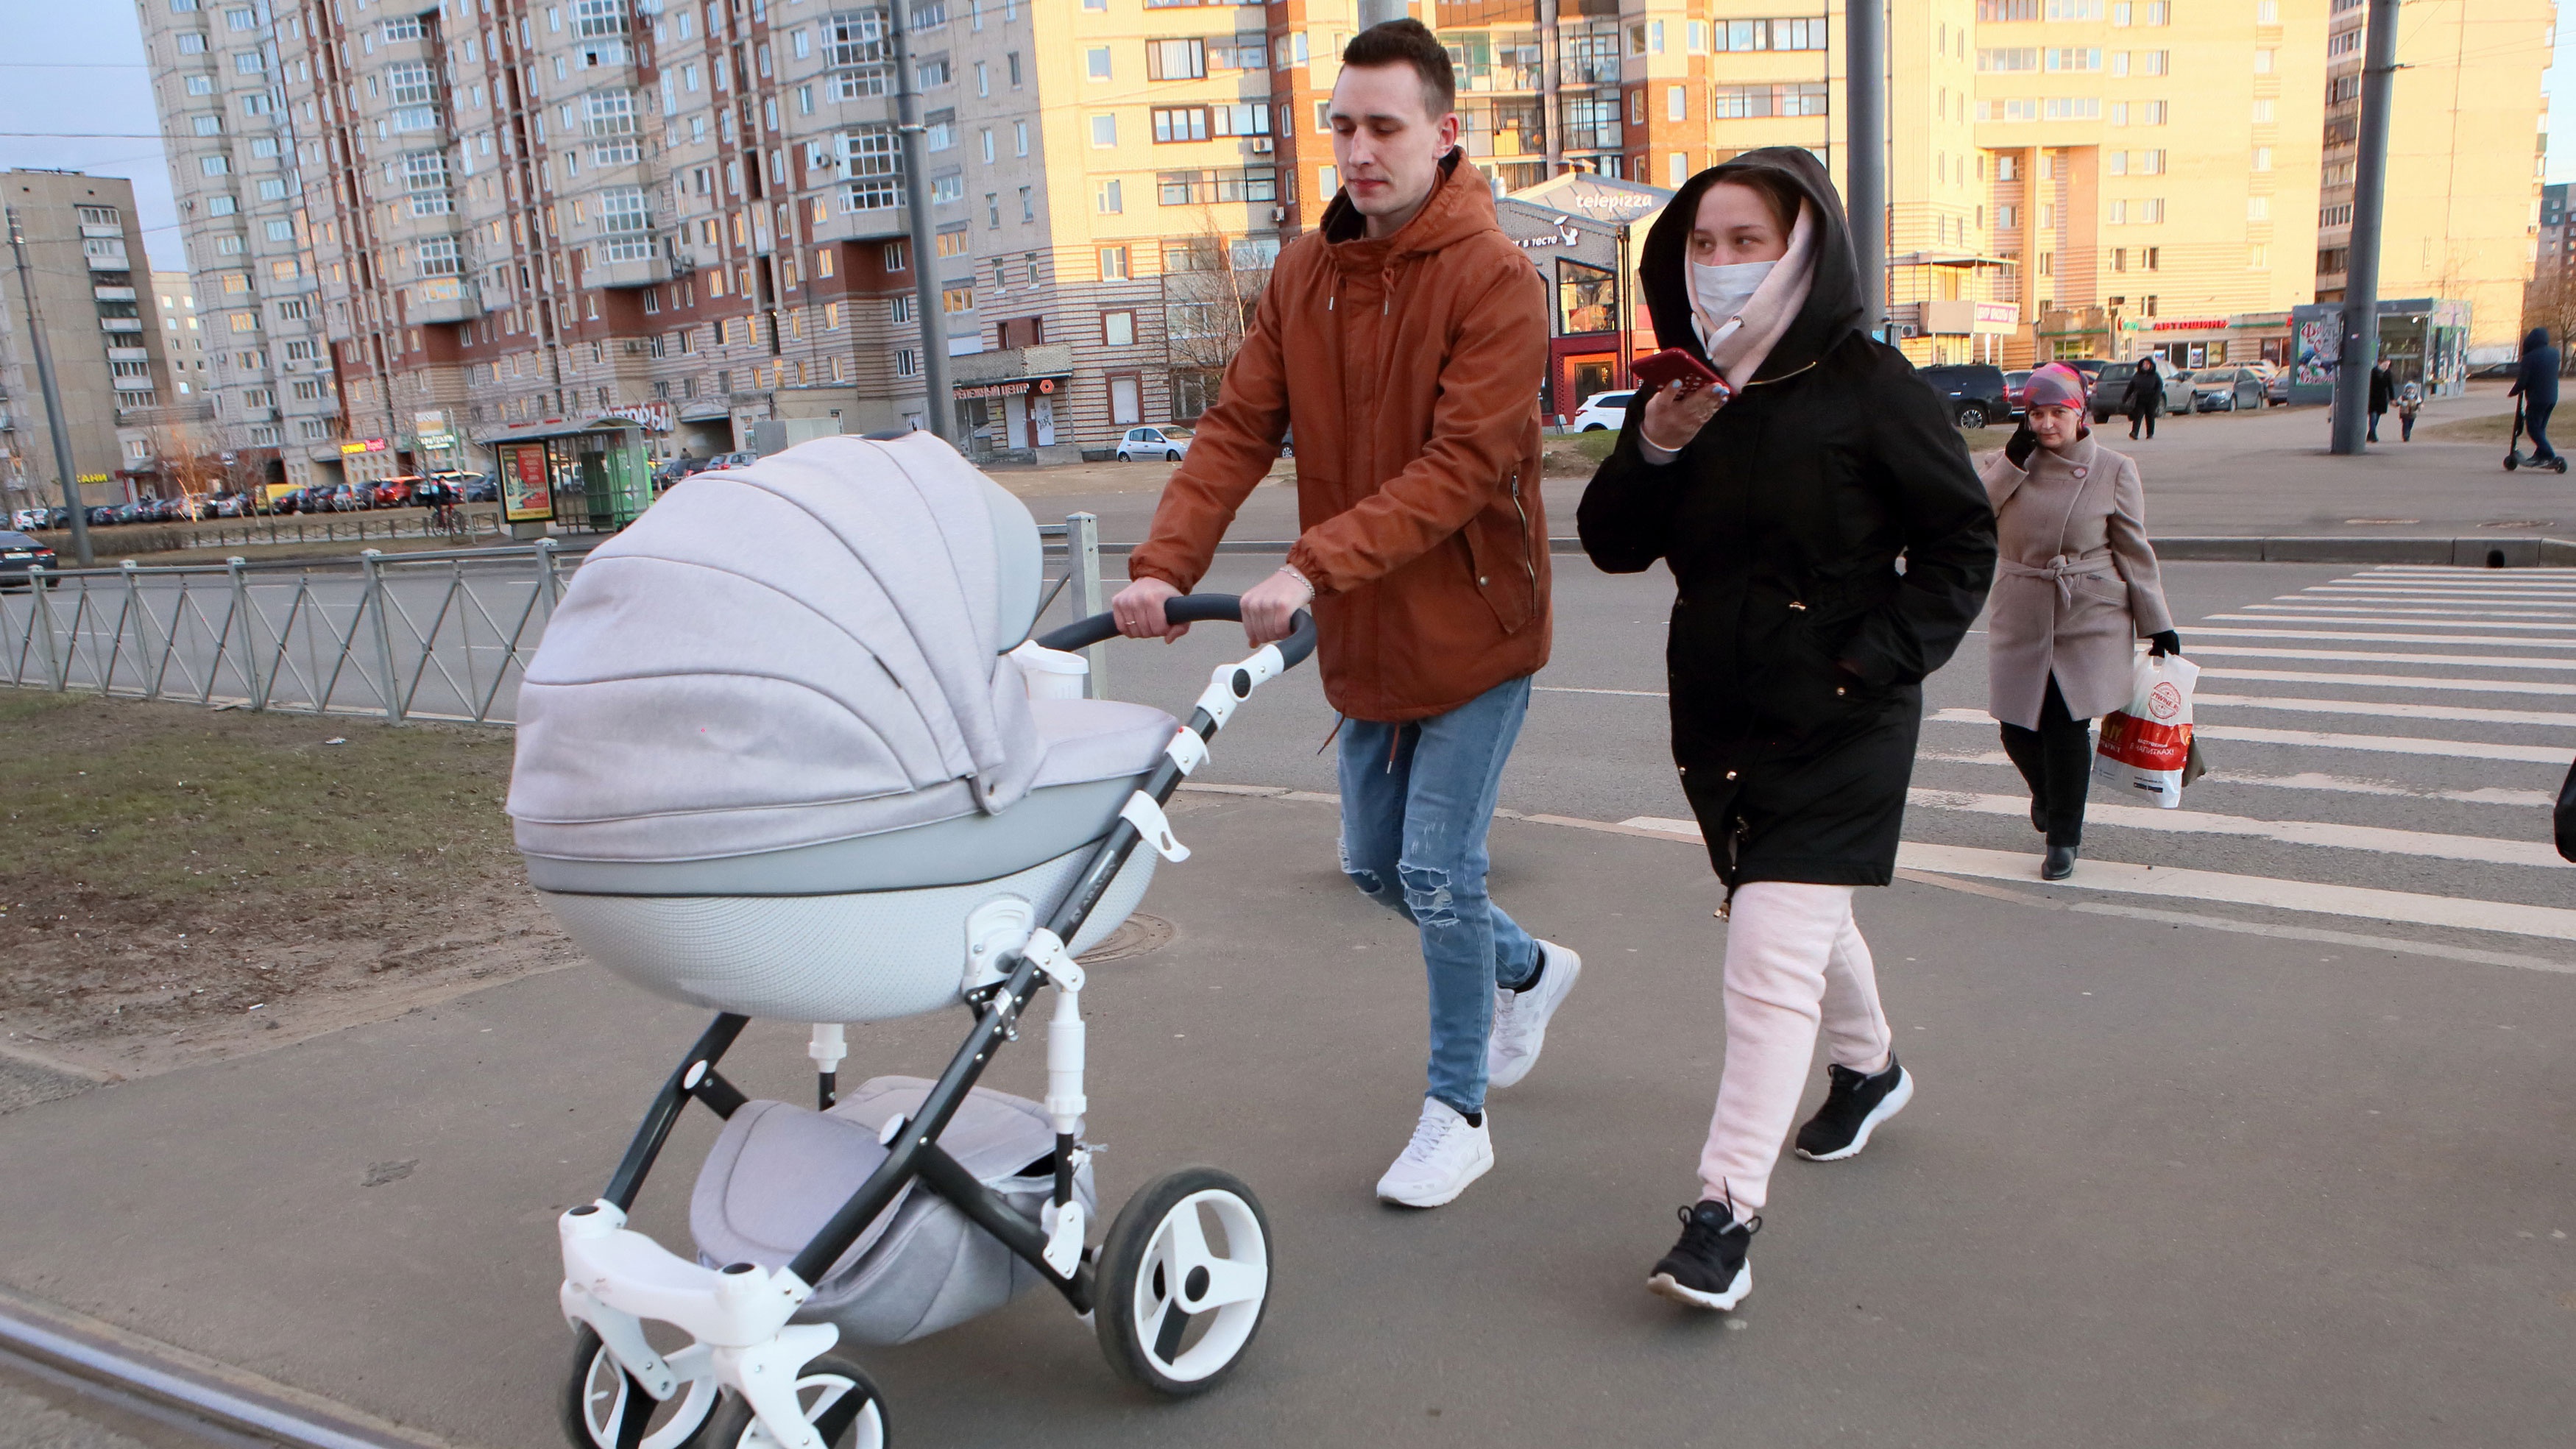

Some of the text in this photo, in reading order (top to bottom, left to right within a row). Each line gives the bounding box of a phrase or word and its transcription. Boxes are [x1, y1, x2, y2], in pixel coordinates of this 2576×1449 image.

[1575, 192, 1652, 213] telepizza
[2154, 319, 2229, 330] АВТОШИНЫ
[952, 383, 1030, 400] РЕПЕЖНЫЙ ЦЕНТР
